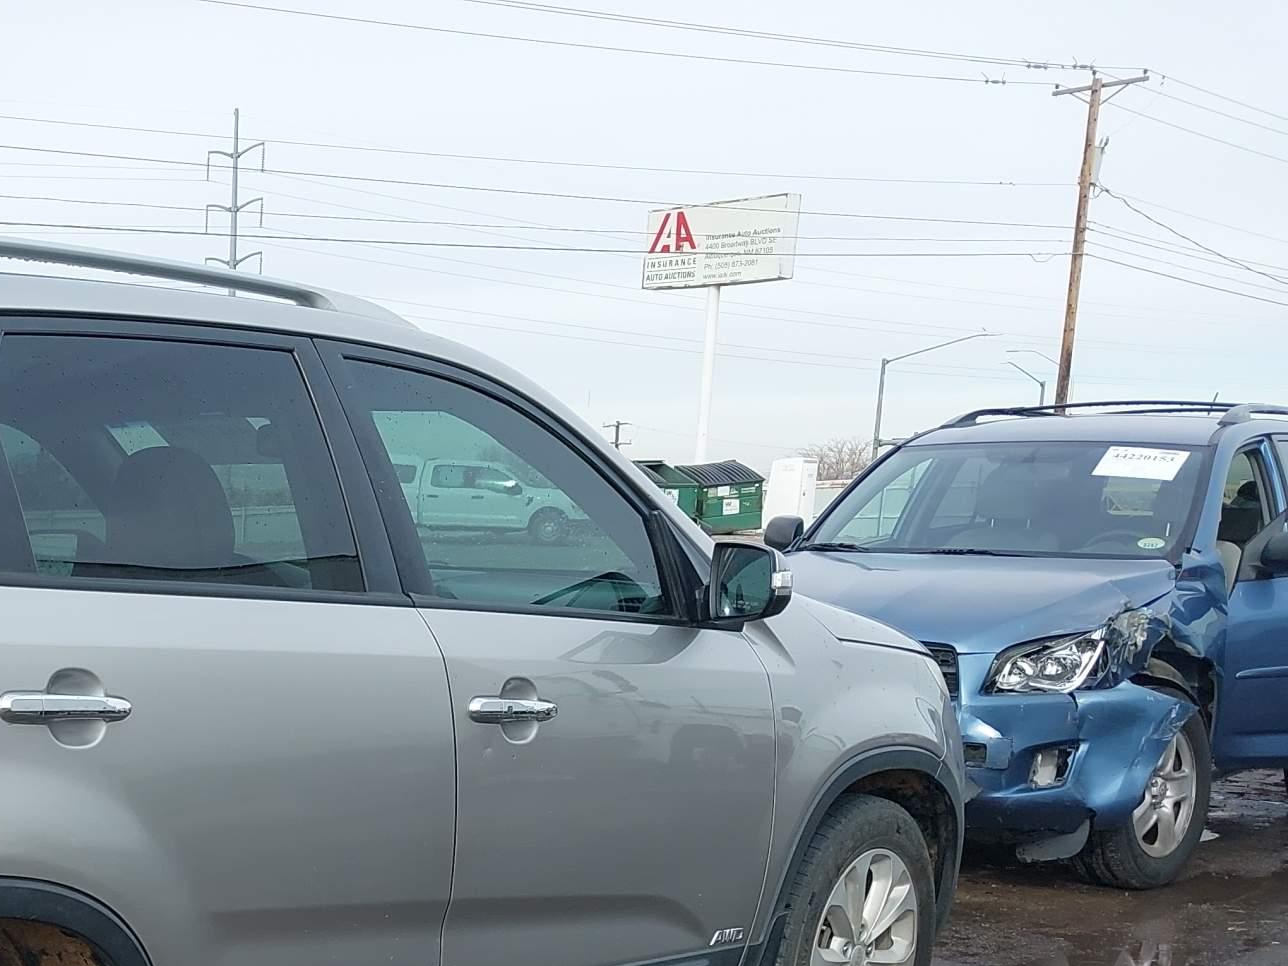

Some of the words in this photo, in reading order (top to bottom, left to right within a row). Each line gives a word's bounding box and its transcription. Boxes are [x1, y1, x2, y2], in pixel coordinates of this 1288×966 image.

[752, 227, 781, 236] Auctions
[647, 256, 697, 269] INSURANCE
[646, 272, 663, 282] AUTO
[663, 270, 696, 281] AUCTIONS
